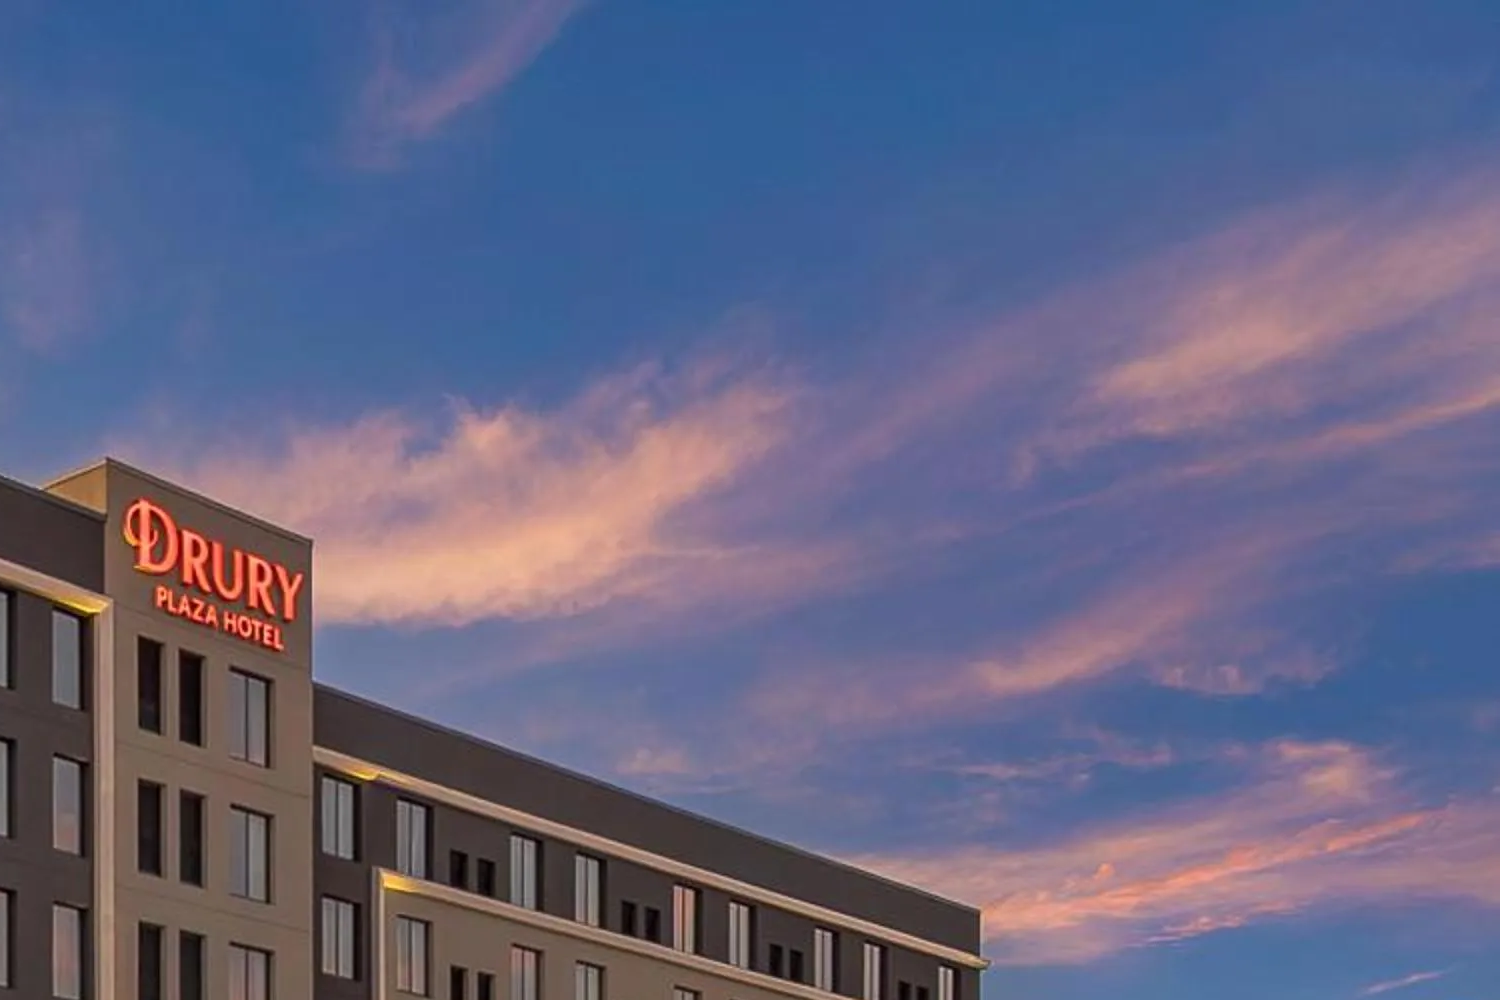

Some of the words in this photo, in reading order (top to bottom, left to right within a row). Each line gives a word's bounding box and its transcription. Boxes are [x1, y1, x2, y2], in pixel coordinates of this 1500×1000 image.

[123, 498, 303, 622] DRURY
[156, 586, 218, 627] PLAZA
[223, 610, 285, 650] HOTEL
